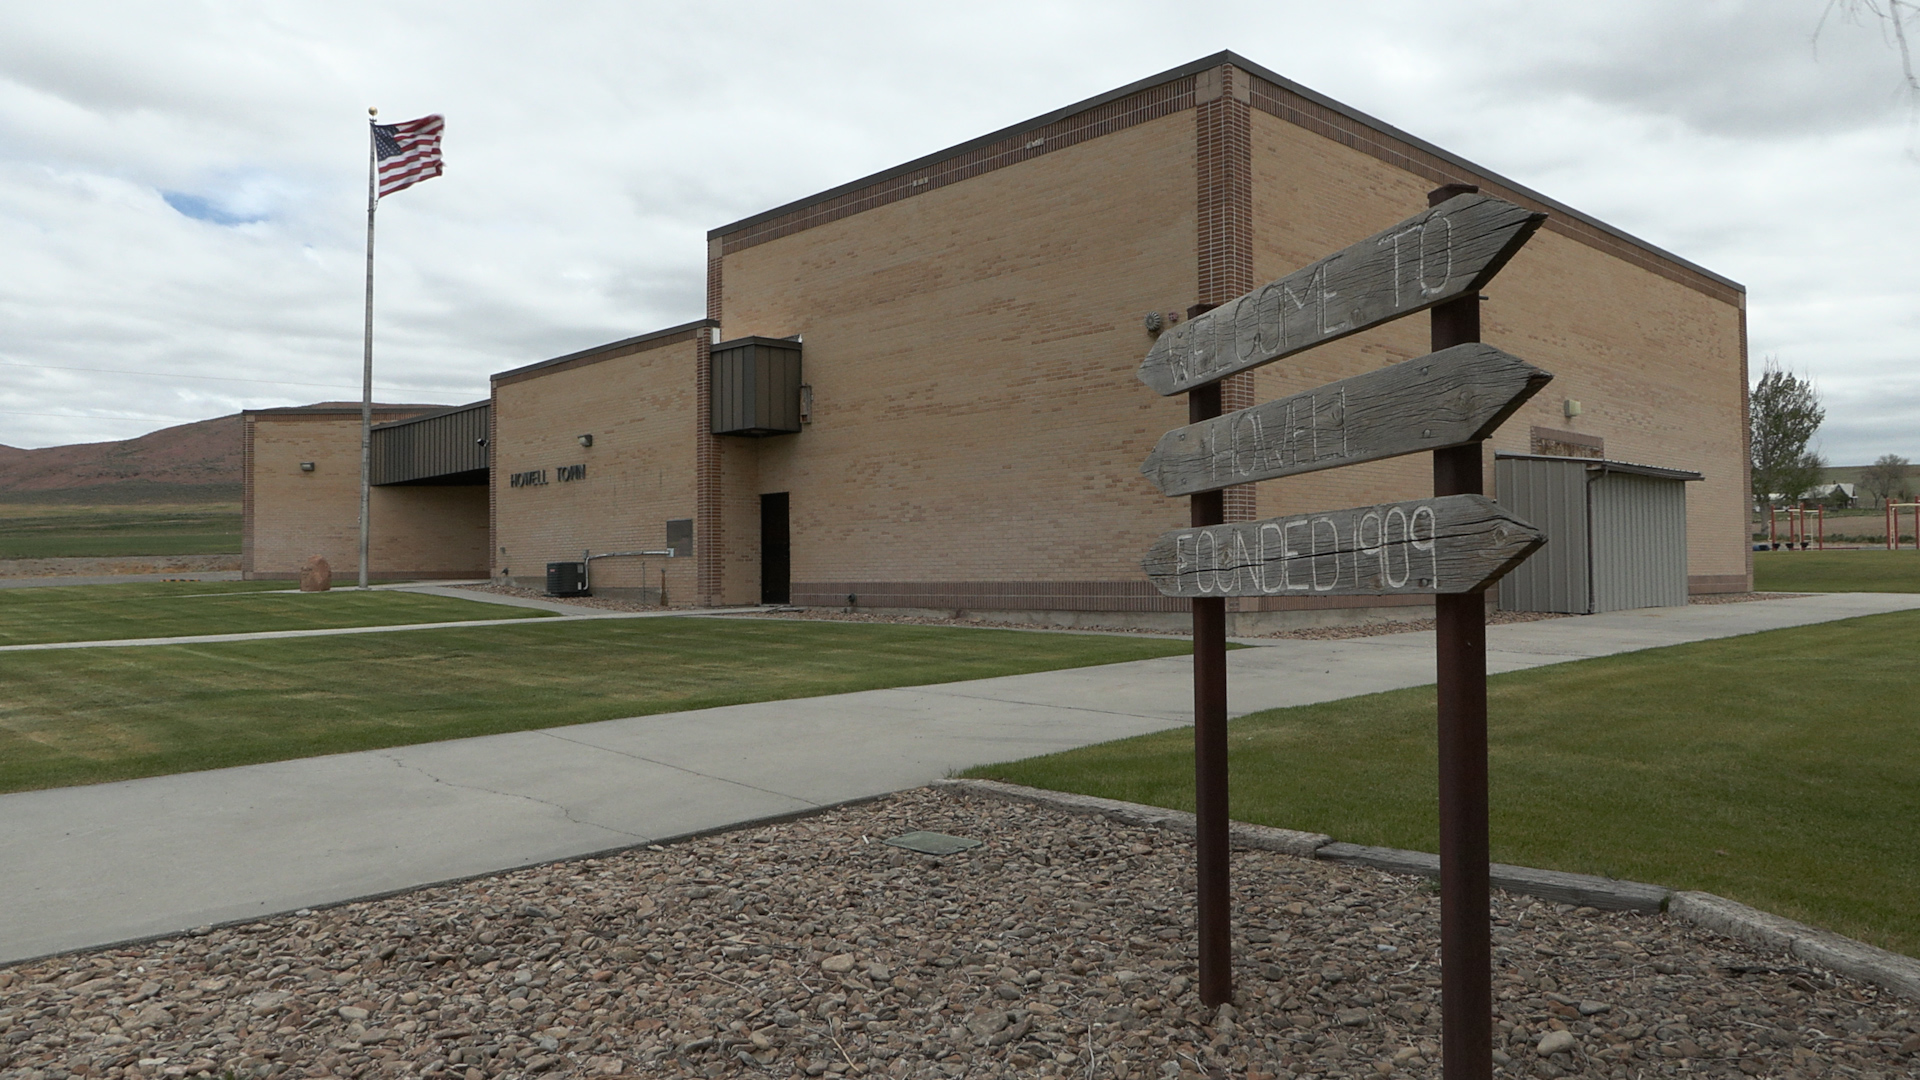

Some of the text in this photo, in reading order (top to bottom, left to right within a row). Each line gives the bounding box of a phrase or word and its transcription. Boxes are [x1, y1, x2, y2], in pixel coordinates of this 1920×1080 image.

[1165, 209, 1453, 387] WELCOME TO
[510, 463, 586, 488] HOWELL TOWN
[1210, 385, 1369, 483] HOWELL
[1175, 505, 1438, 594] FOUNDED 1909
